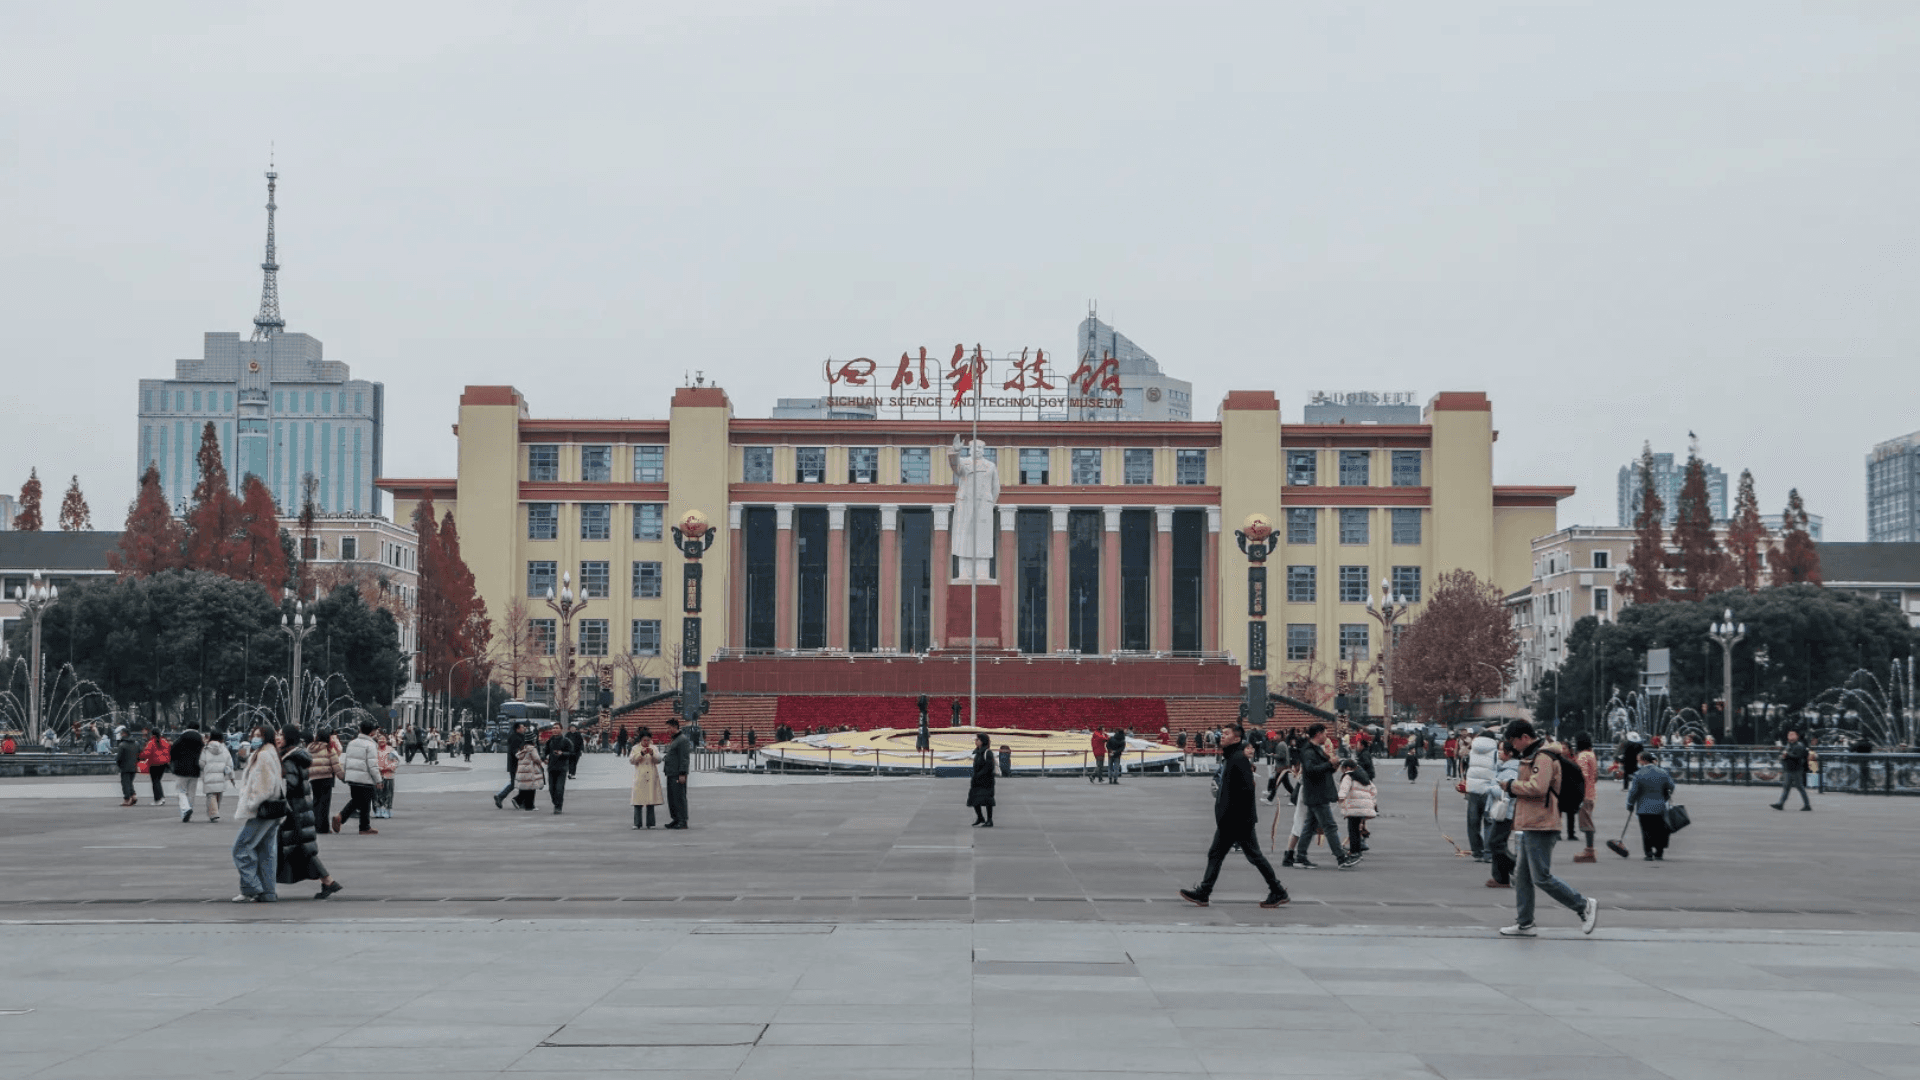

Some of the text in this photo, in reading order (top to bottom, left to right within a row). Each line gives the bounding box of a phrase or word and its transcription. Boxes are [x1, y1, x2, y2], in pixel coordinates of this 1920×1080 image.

[826, 396, 883, 407] SICHUAN
[889, 396, 942, 407] SCIENCE
[982, 397, 1065, 407] TECHNOLOGY
[1070, 397, 1123, 407] MUSEUM
